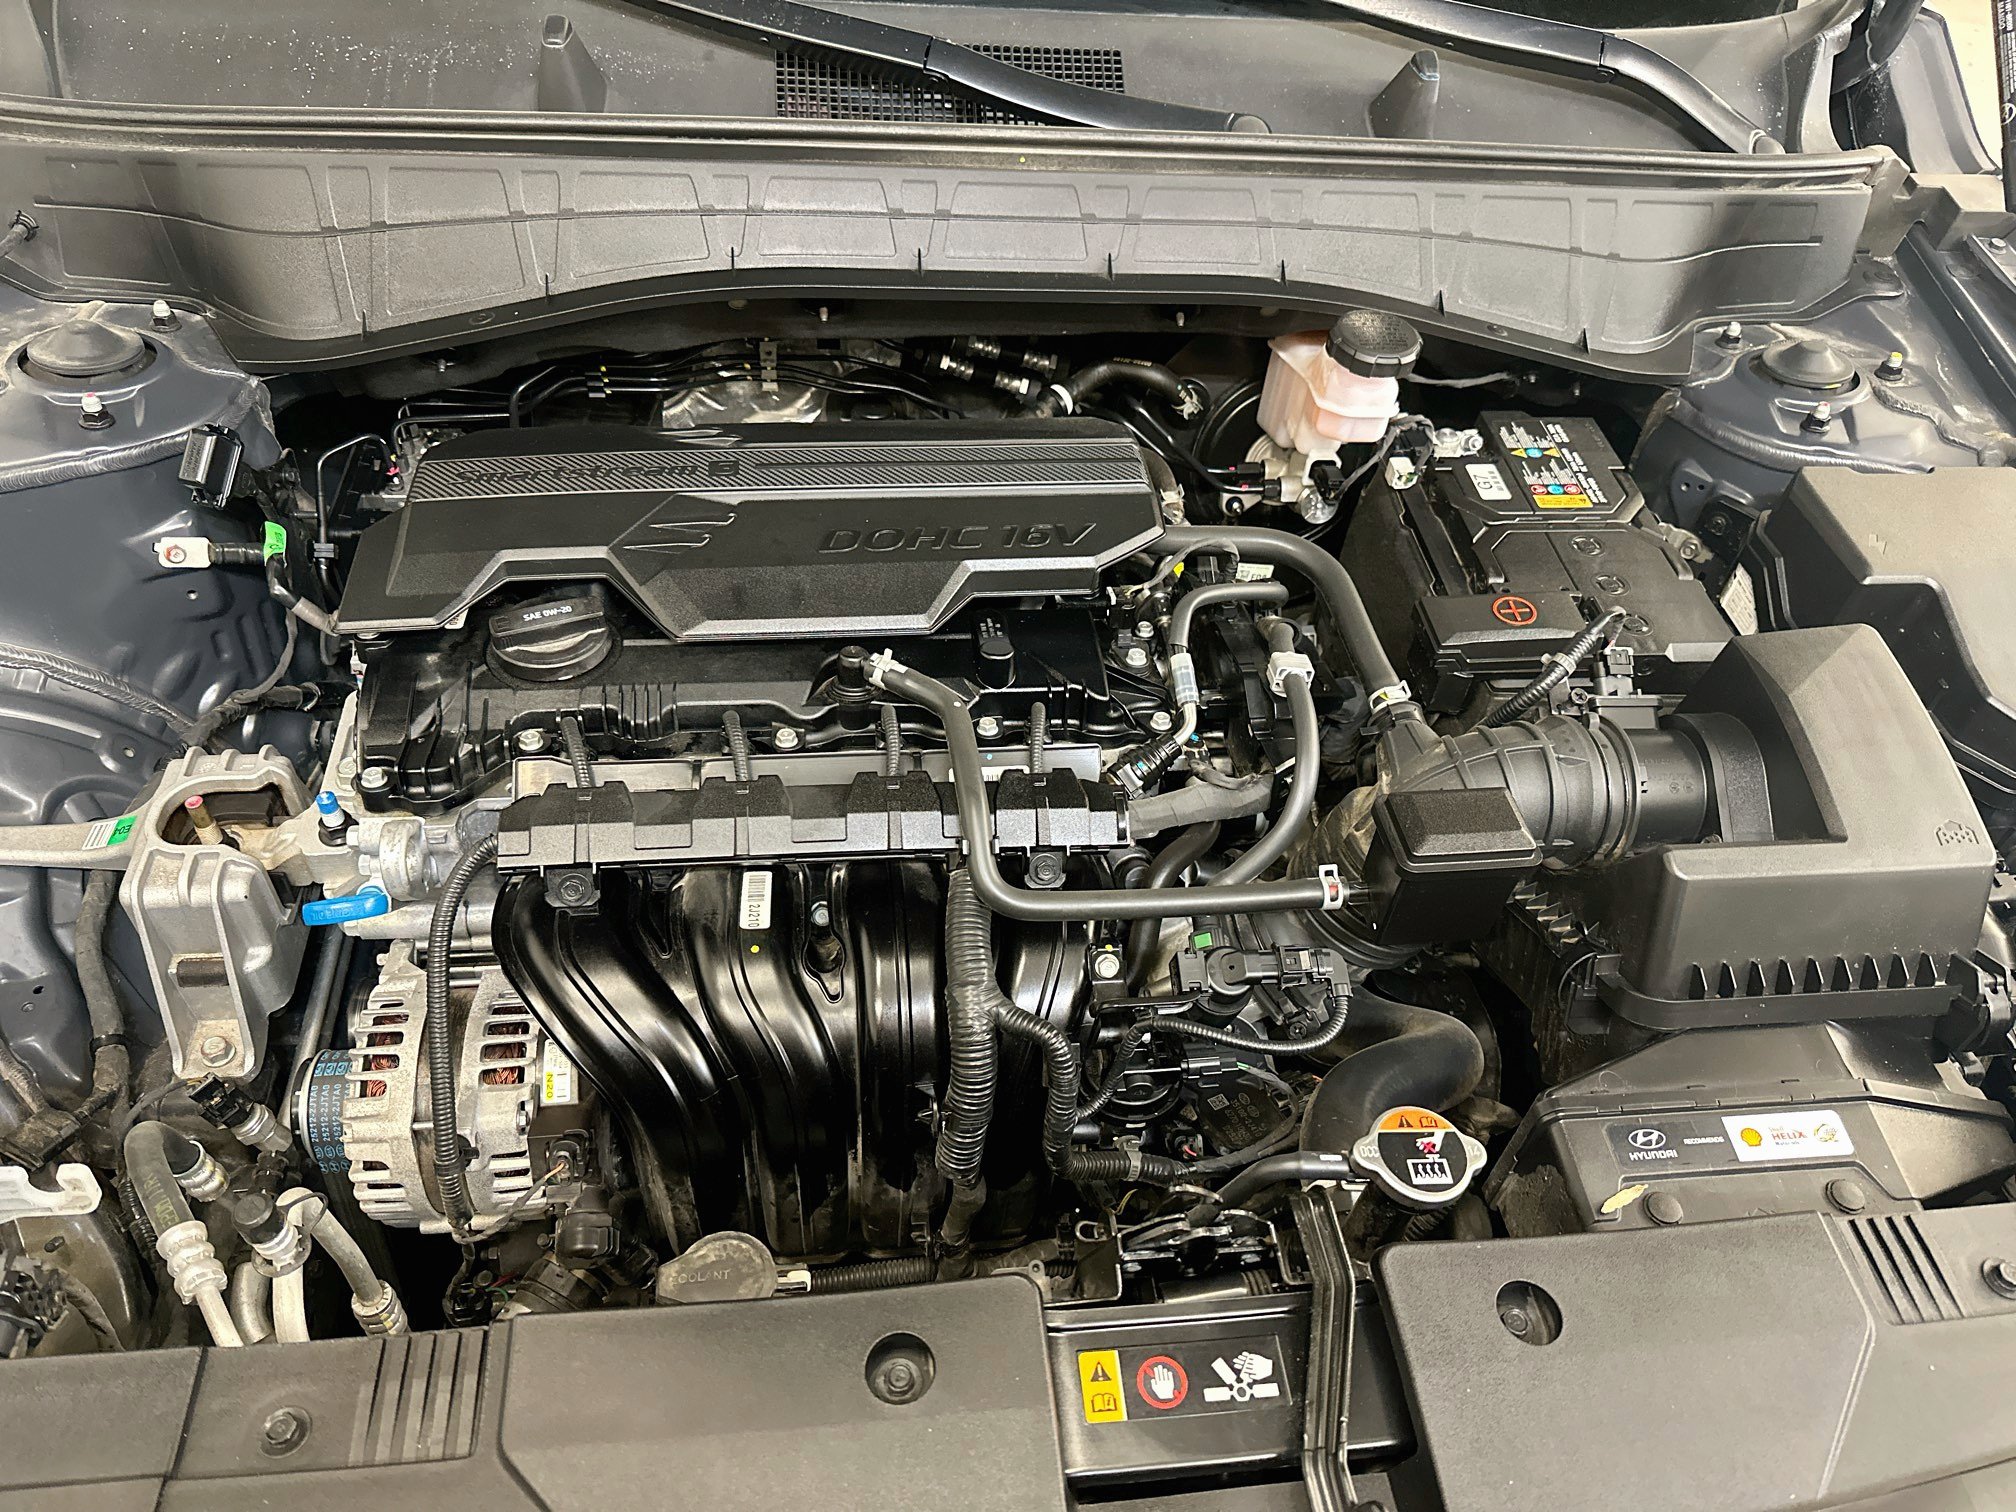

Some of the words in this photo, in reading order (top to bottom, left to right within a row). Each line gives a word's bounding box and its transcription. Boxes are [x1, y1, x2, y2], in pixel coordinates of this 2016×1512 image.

[449, 463, 699, 485] Smartstream
[1473, 474, 1493, 490] G7
[819, 525, 989, 554] DOHC
[1001, 523, 1097, 549] 16V
[522, 611, 543, 622] SAE
[542, 605, 573, 618] 0W-20
[747, 903, 761, 928] 2J210
[546, 1073, 554, 1099] N20
[309, 1085, 319, 1143] 25212-2JTA0
[320, 1084, 331, 1142] 25212-2JTA0
[1683, 1135, 1725, 1145] RECOMMENDS
[1771, 1129, 1809, 1141] HELIX
[1628, 1149, 1679, 1161] HYUNDAI
[672, 1268, 732, 1285] COOLANT
